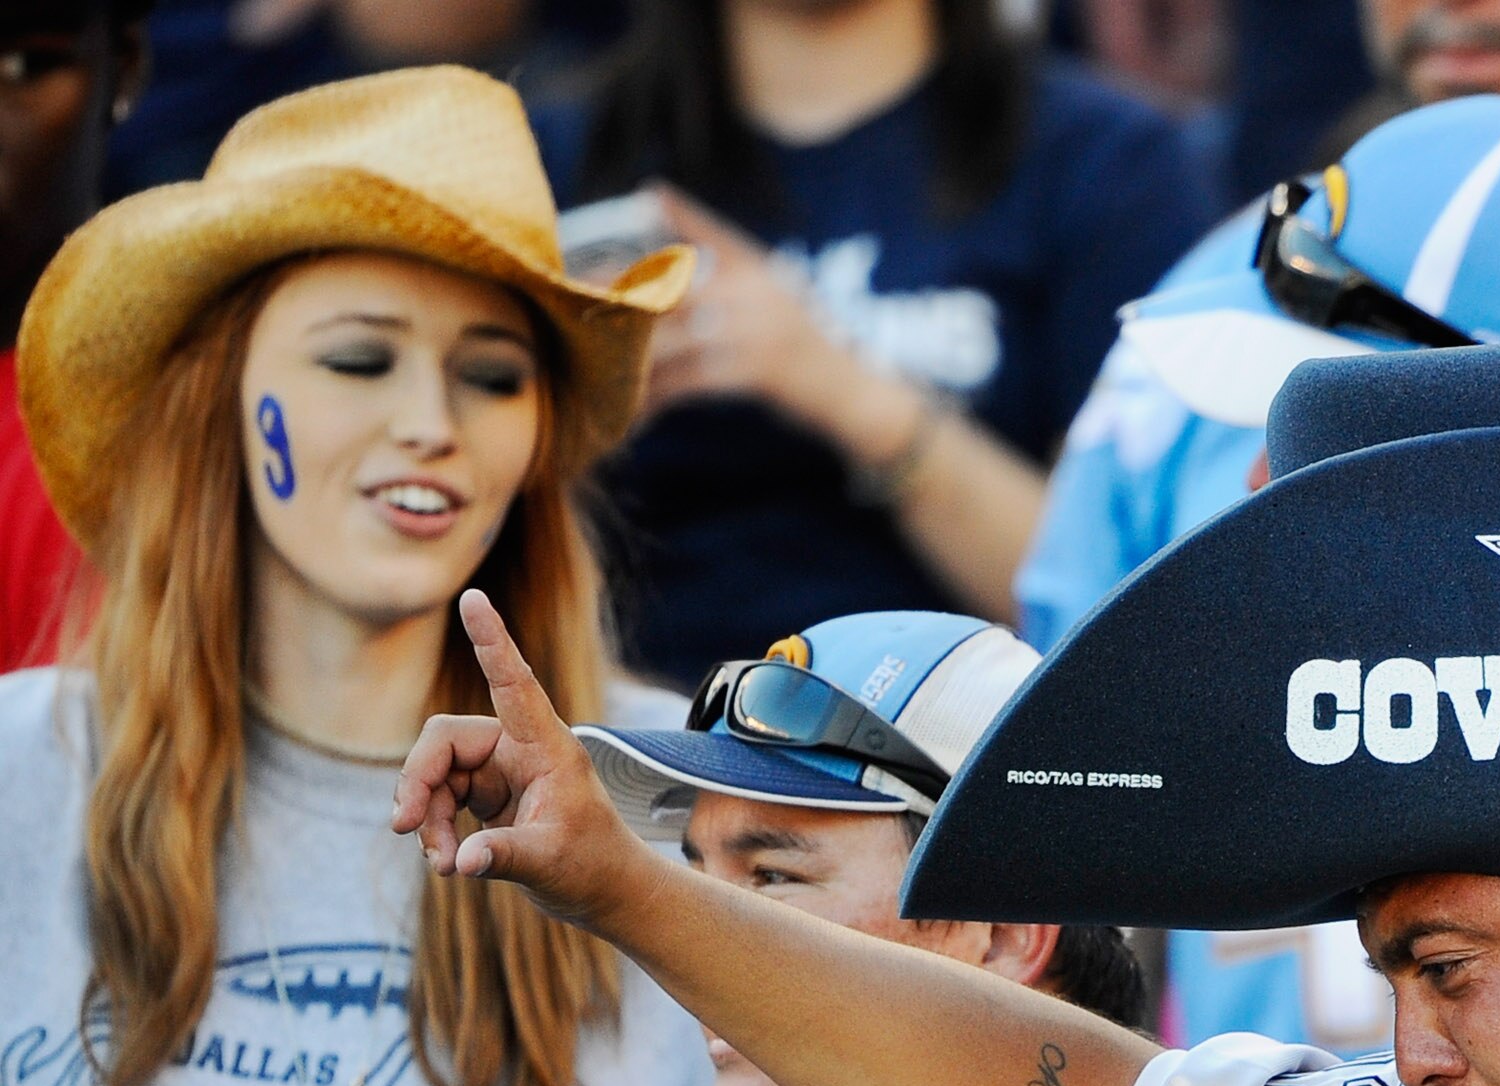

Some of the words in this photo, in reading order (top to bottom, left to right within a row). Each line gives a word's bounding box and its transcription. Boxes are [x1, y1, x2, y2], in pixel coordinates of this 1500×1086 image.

[1007, 770, 1084, 786] RICO/TAG
[1087, 772, 1164, 789] EXPRESS
[188, 1031, 339, 1086] ALLAS
